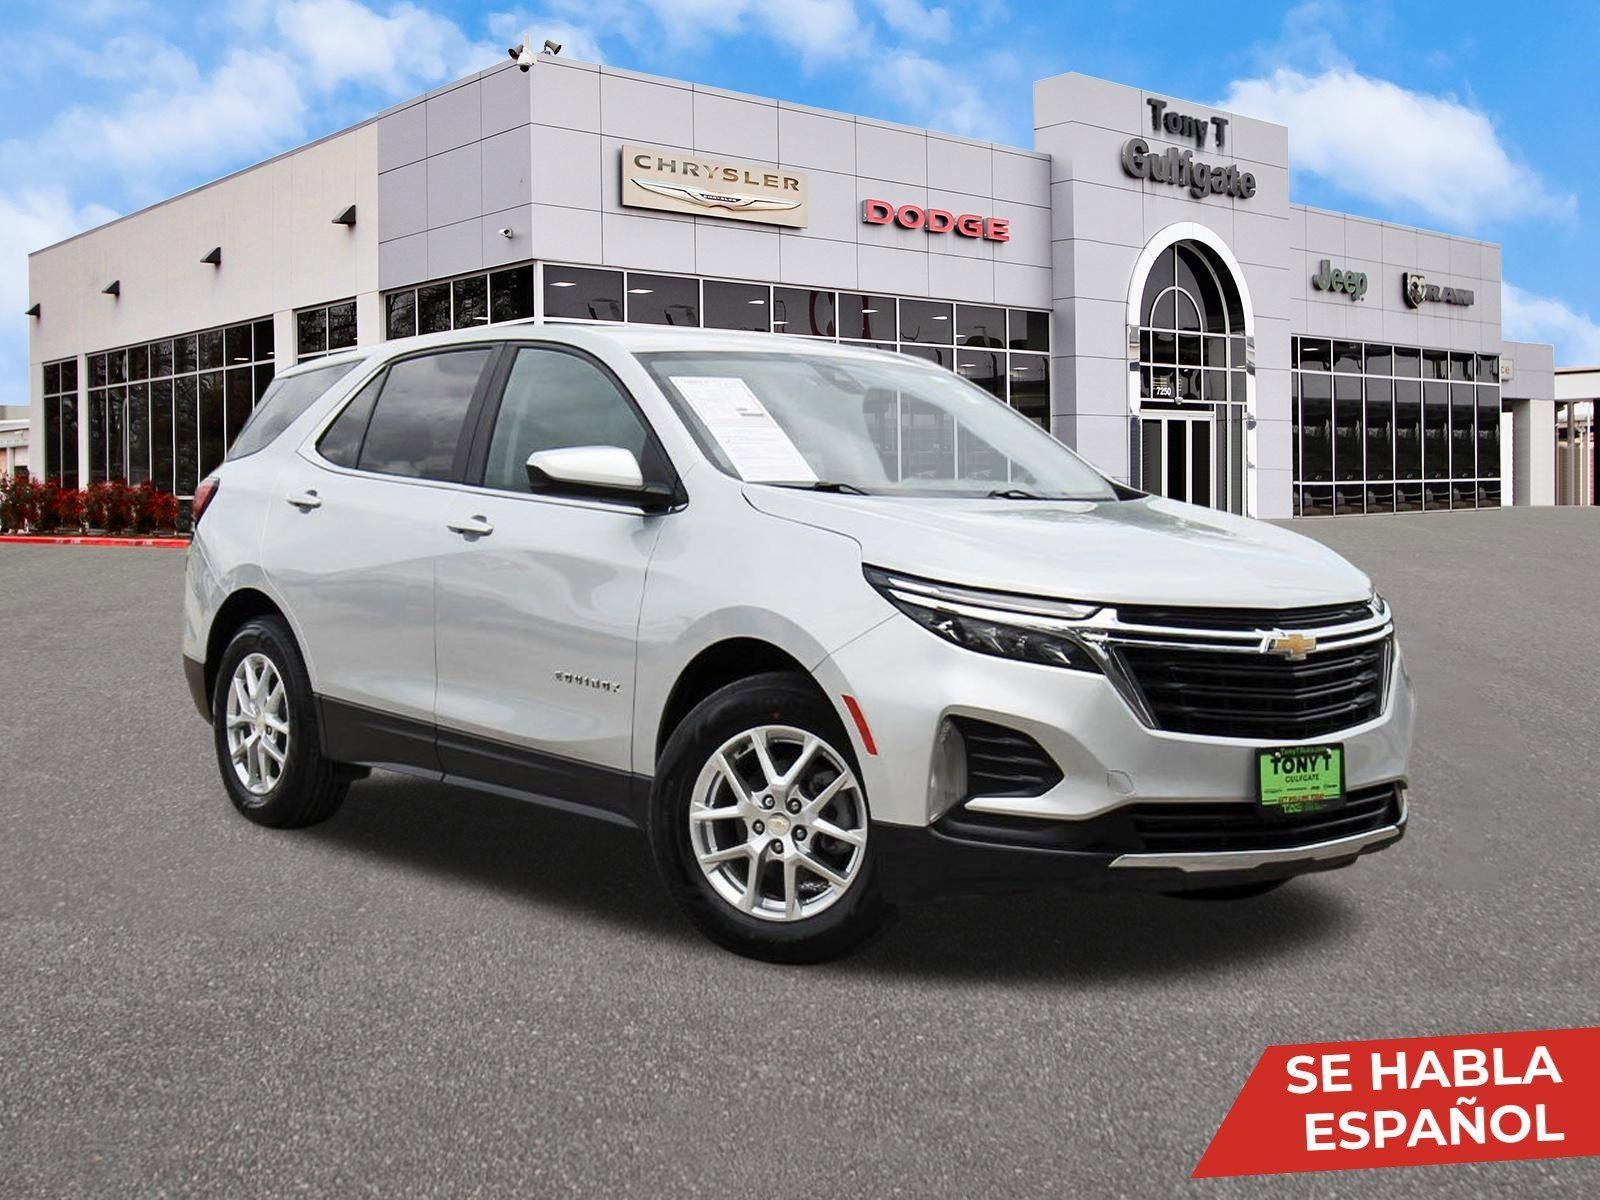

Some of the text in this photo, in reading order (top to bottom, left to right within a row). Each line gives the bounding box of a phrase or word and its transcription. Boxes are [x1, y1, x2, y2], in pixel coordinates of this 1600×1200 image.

[1147, 98, 1229, 148] Tony T
[633, 154, 800, 192] CHRYSLER
[1121, 137, 1257, 199] Gulfgate
[862, 198, 1010, 243] DODGE
[1312, 259, 1368, 302] Jeep
[1424, 283, 1475, 307] RAM
[1270, 754, 1332, 775] TONY T
